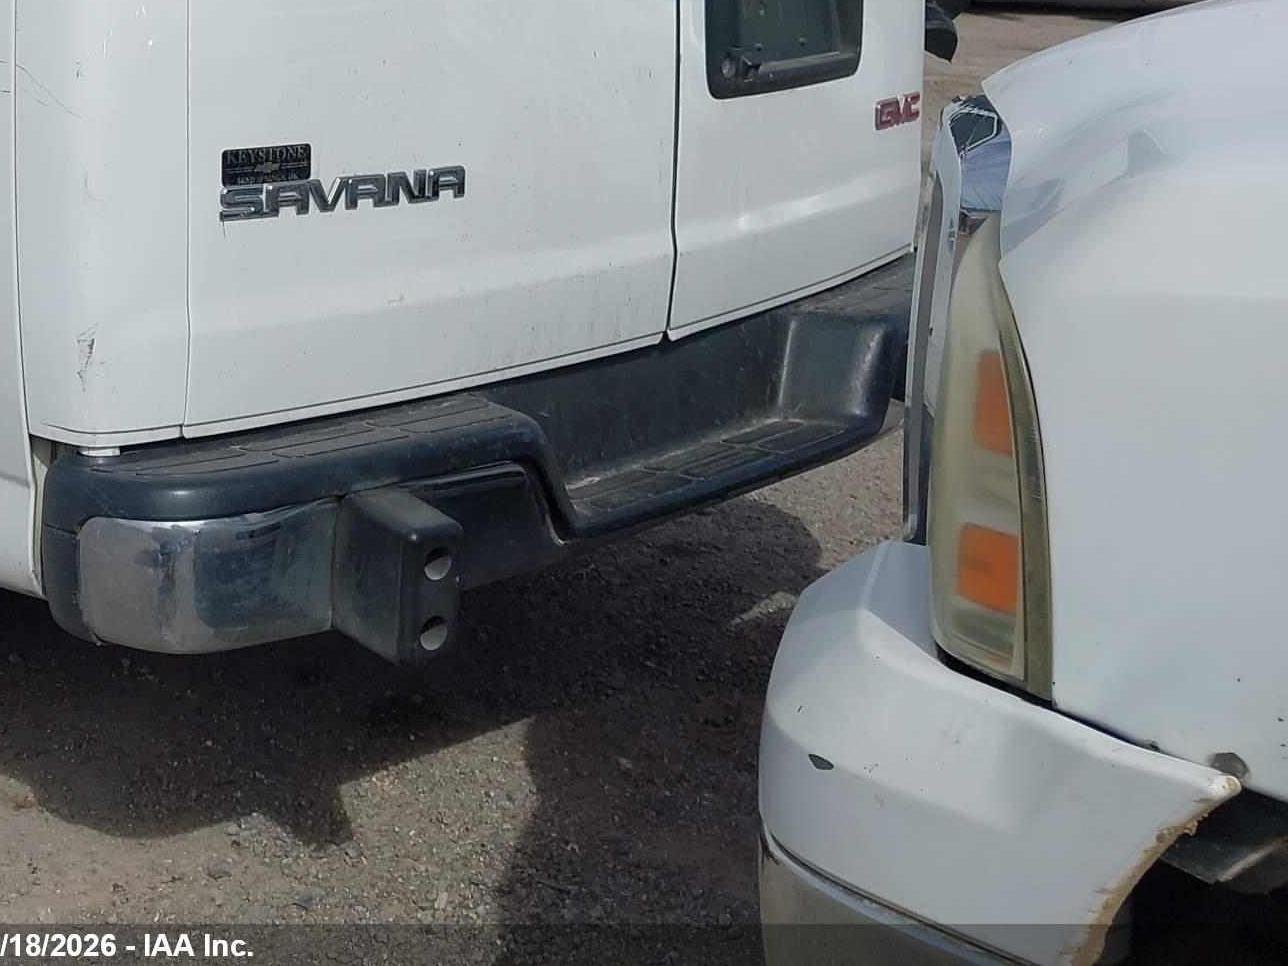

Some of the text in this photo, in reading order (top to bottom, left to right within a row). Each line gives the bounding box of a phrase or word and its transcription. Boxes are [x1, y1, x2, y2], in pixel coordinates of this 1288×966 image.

[874, 91, 921, 131] GMC
[226, 145, 307, 164] KEYSTONE
[219, 165, 467, 221] SAVANA
